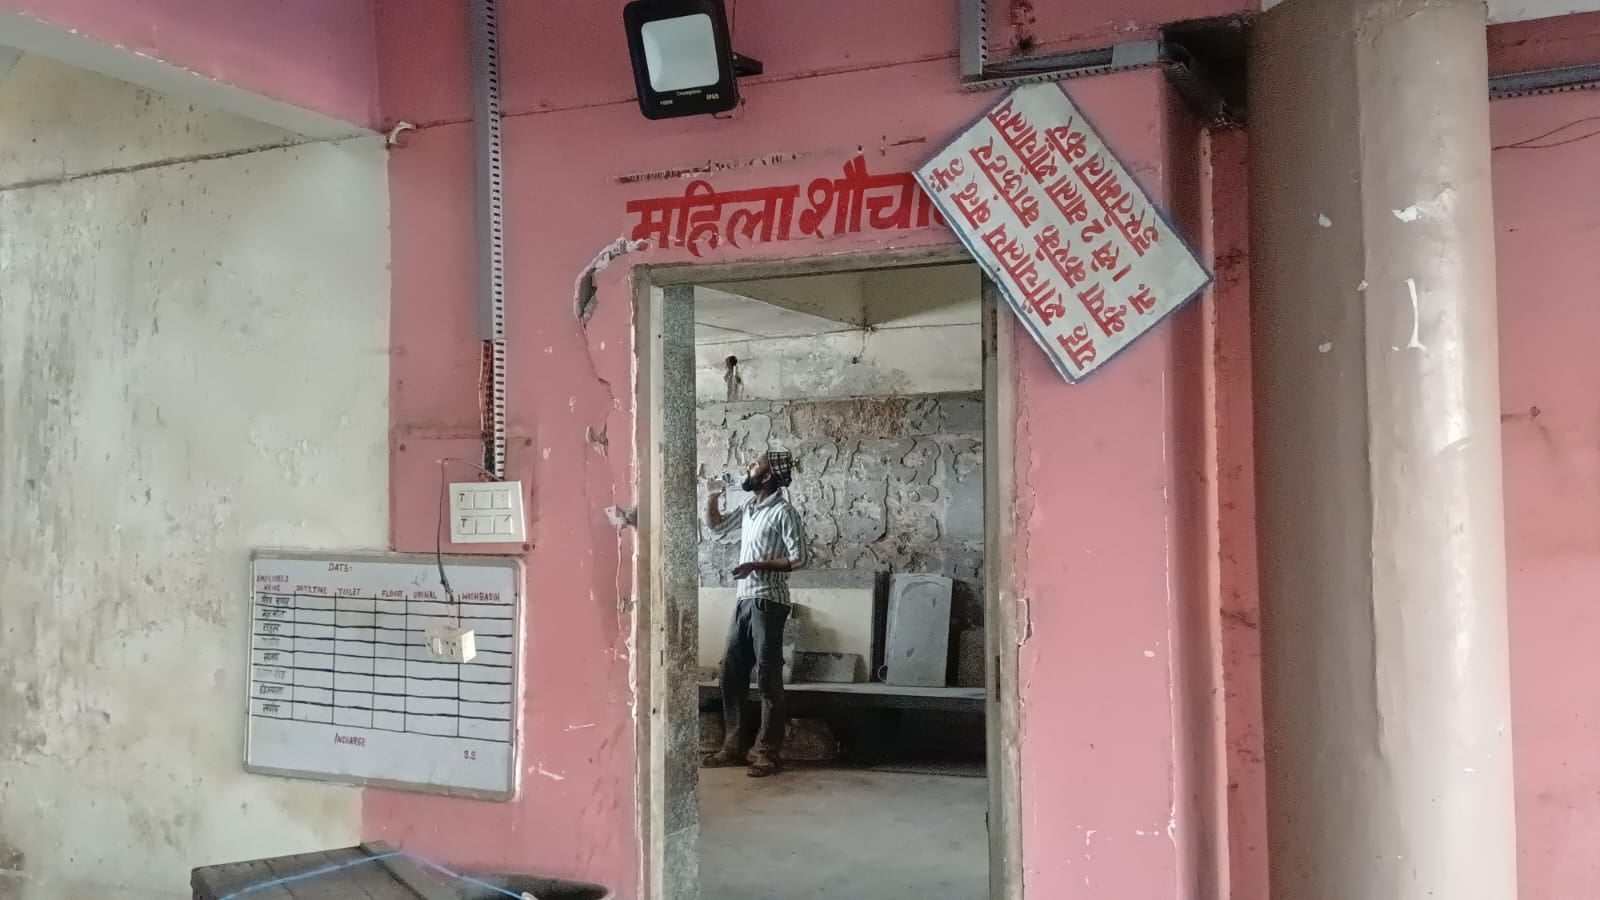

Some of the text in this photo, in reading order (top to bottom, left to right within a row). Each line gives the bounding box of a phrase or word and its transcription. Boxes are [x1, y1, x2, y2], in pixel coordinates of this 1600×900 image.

[988, 100, 1057, 184] शौचालय
[626, 155, 951, 258] महिला शौचा
[1044, 116, 1158, 255] इस्तेमाल करें
[1044, 176, 1088, 224] वाला
[1081, 218, 1104, 243] 2
[981, 223, 1065, 325] शौचालय
[1034, 225, 1086, 288] करके
[1077, 282, 1126, 336] कृपा
[1057, 326, 1096, 369] यह
[337, 587, 361, 596] TOILET
[381, 589, 404, 598] FLOOR
[413, 591, 438, 600] URINAL
